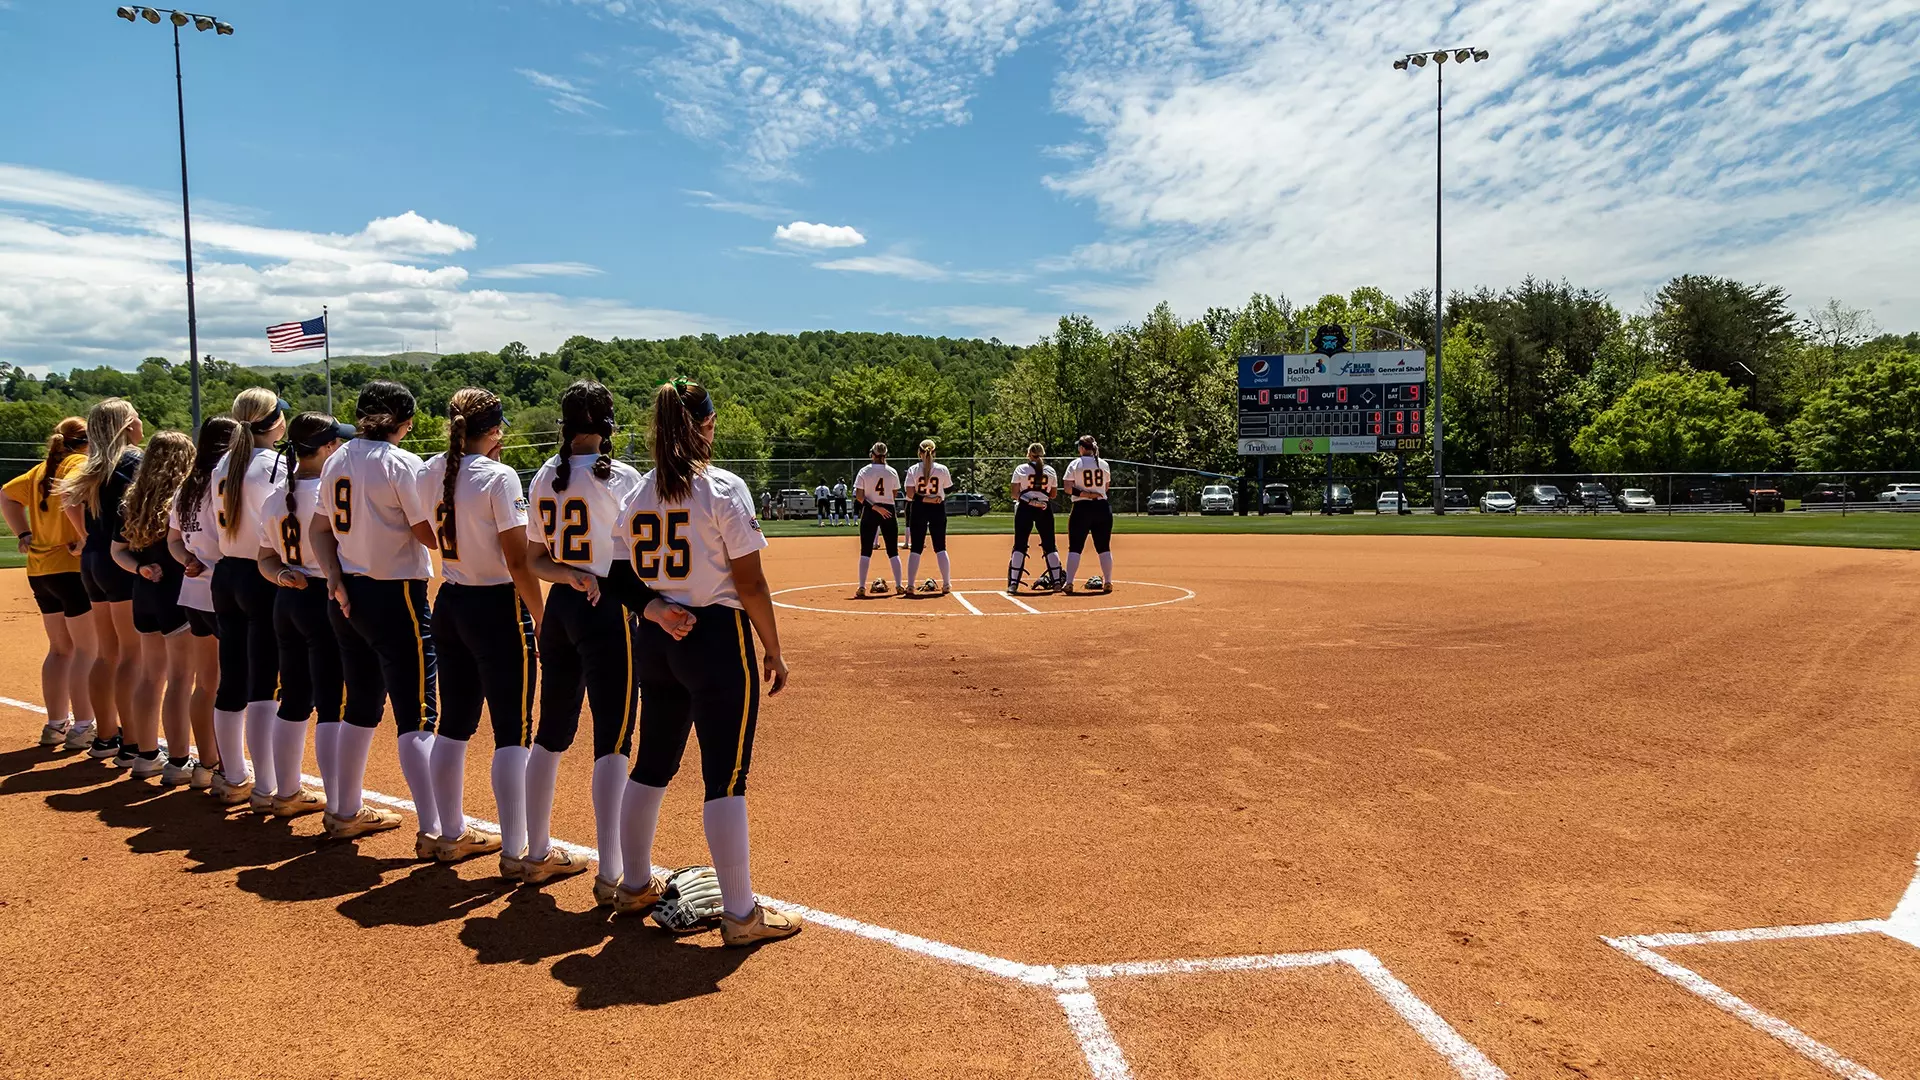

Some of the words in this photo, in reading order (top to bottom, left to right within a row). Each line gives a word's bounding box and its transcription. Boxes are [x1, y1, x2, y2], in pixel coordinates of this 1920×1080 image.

[1260, 390, 1268, 404] 0
[1298, 388, 1307, 403] 0
[1337, 387, 1346, 402] 0
[1410, 385, 1418, 400] 9
[1374, 411, 1380, 420] 0
[1396, 411, 1402, 420] 0
[1413, 411, 1418, 420] 0
[1374, 424, 1380, 434] 0
[1396, 423, 1402, 433] 0
[1413, 423, 1418, 433] 0
[1397, 439, 1422, 449] 2017
[918, 476, 939, 495] 23
[1083, 469, 1104, 487] 88
[875, 477, 885, 496] 4
[334, 476, 352, 534] 9
[538, 497, 593, 563] 22
[280, 515, 304, 567] 8
[630, 508, 693, 581] 25
